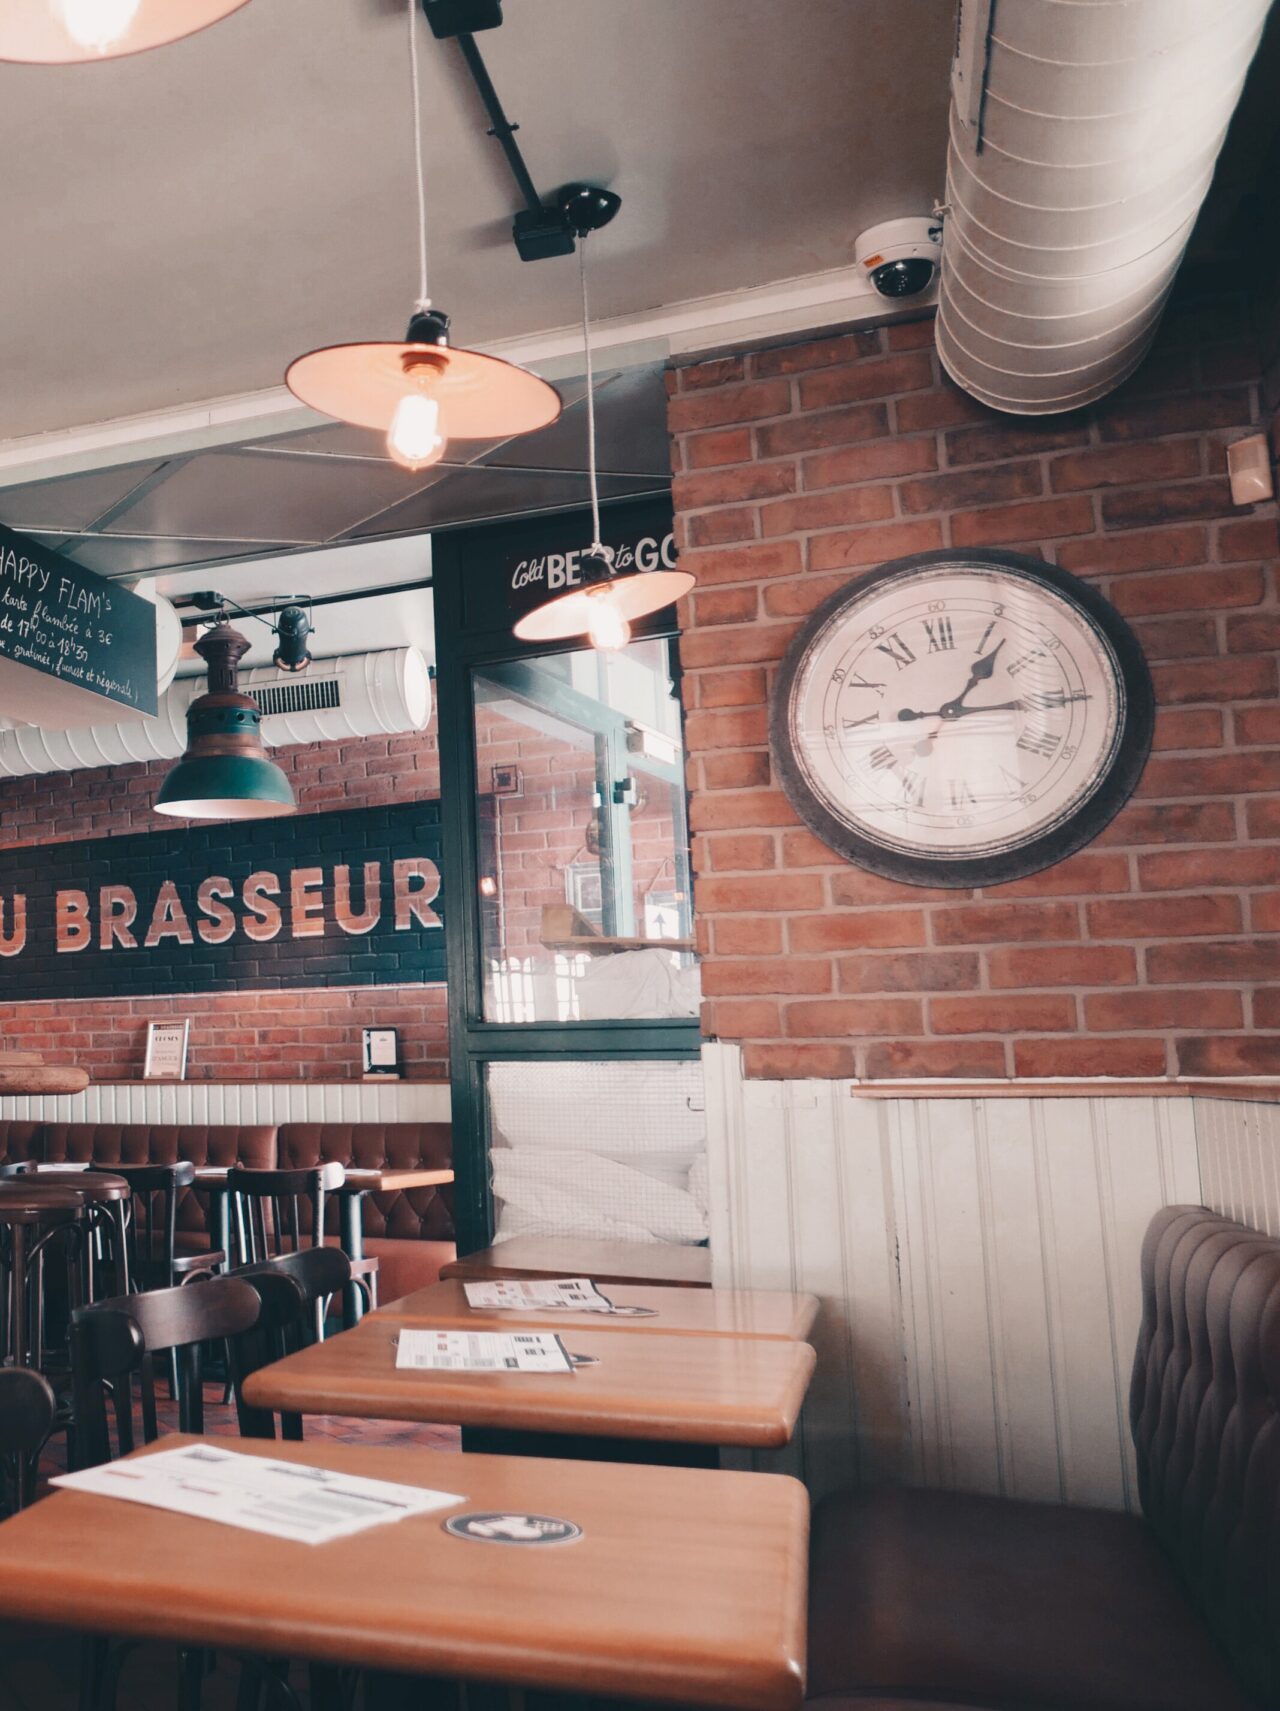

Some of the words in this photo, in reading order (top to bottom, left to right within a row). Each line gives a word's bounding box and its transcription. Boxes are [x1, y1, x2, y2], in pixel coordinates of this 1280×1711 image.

[511, 556, 546, 590] Cold
[547, 546, 617, 590] BER
[615, 544, 634, 569] to
[58, 577, 112, 619] FLAM's
[0, 613, 13, 634] de
[48, 632, 56, 649] à
[33, 599, 79, 635] flambée
[86, 622, 93, 639] à
[98, 630, 113, 645] 3€
[921, 615, 957, 654] XII
[874, 632, 917, 671] XI
[85, 669, 95, 683] et
[832, 667, 846, 684] 50
[55, 857, 444, 954] BRASSEUR
